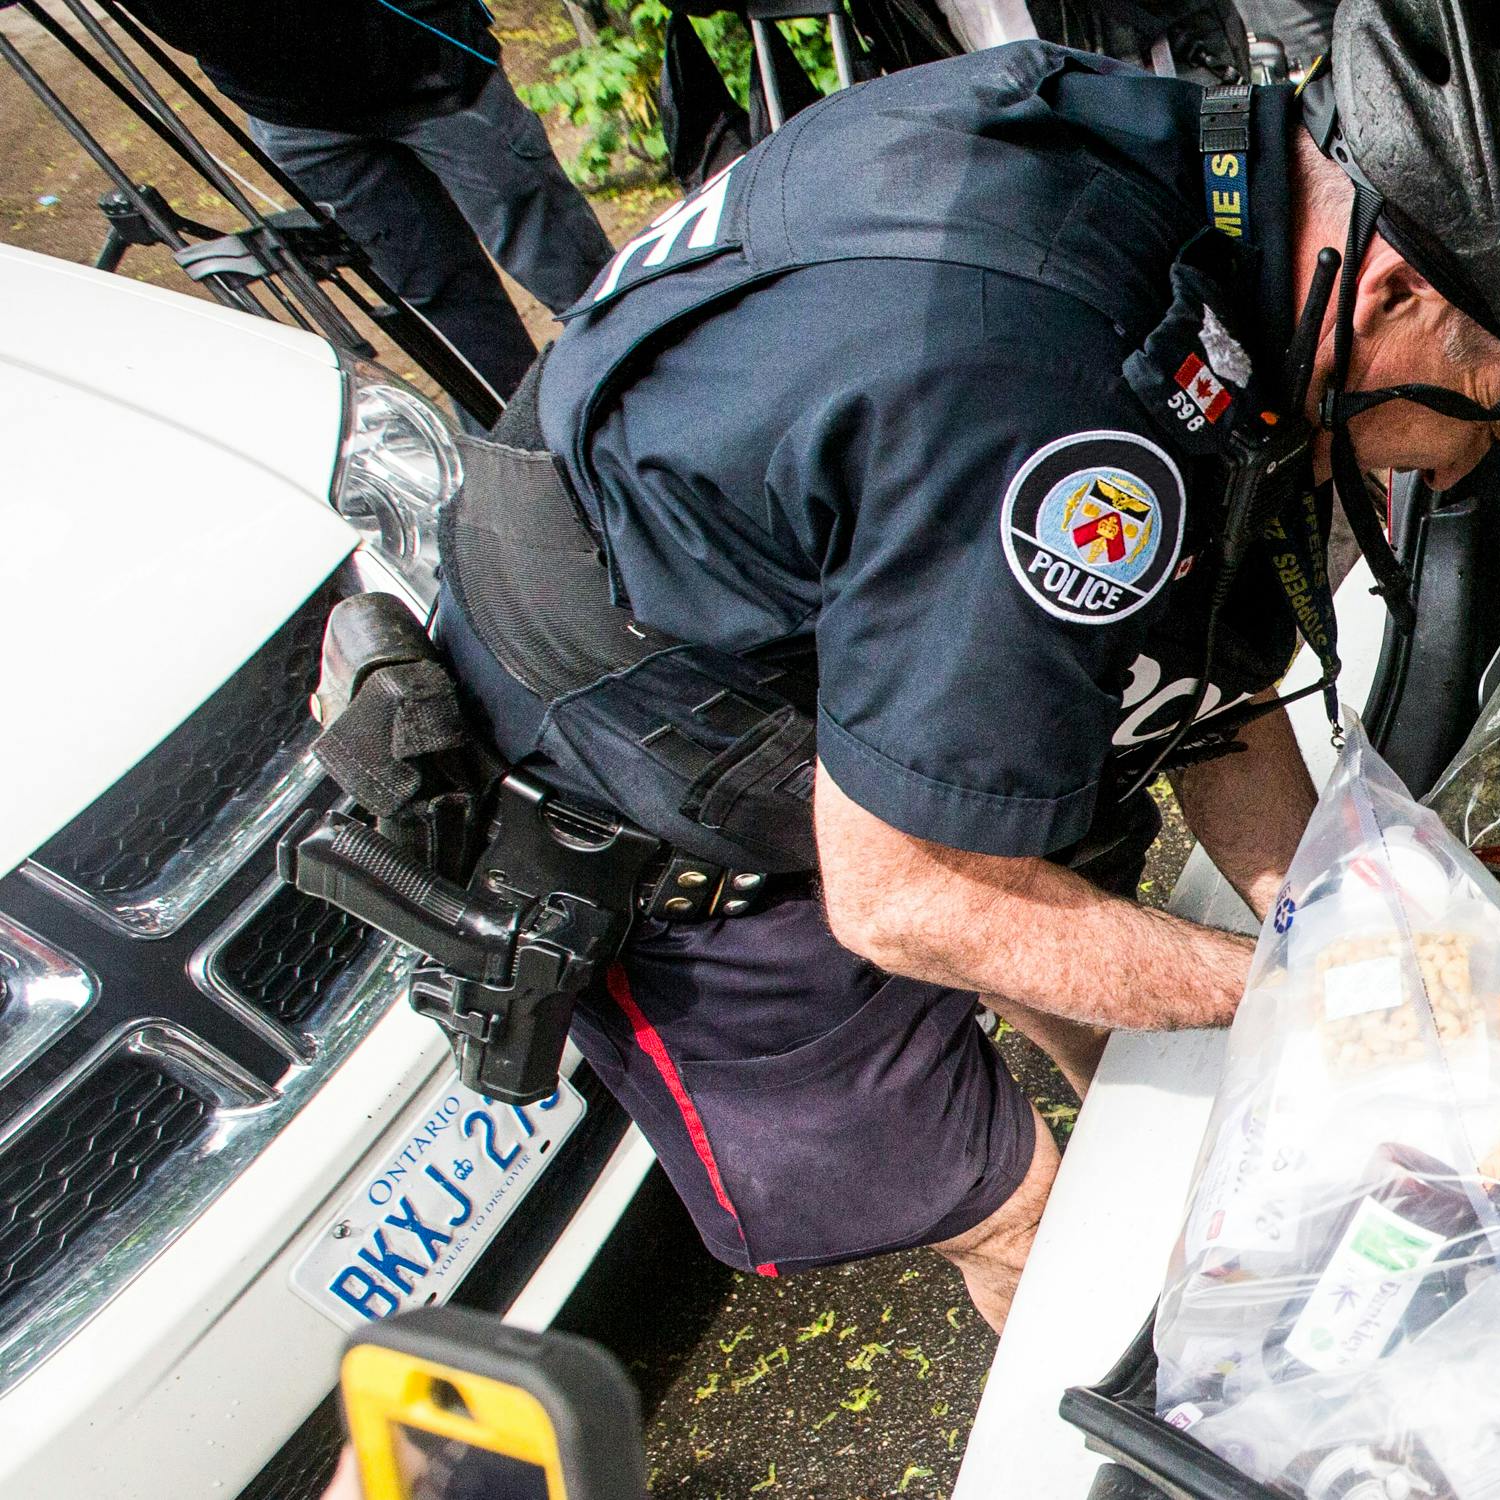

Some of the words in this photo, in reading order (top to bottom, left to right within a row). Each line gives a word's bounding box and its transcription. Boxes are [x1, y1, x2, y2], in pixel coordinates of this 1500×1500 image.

[1167, 391, 1205, 431] 598
[1028, 550, 1124, 610] POLICE
[368, 1096, 460, 1206] ONTARIO
[328, 1163, 473, 1323] BKXJ
[436, 1236, 470, 1279] YOURS
[472, 1214, 485, 1233] TO
[487, 1153, 532, 1215] DISCOVER
